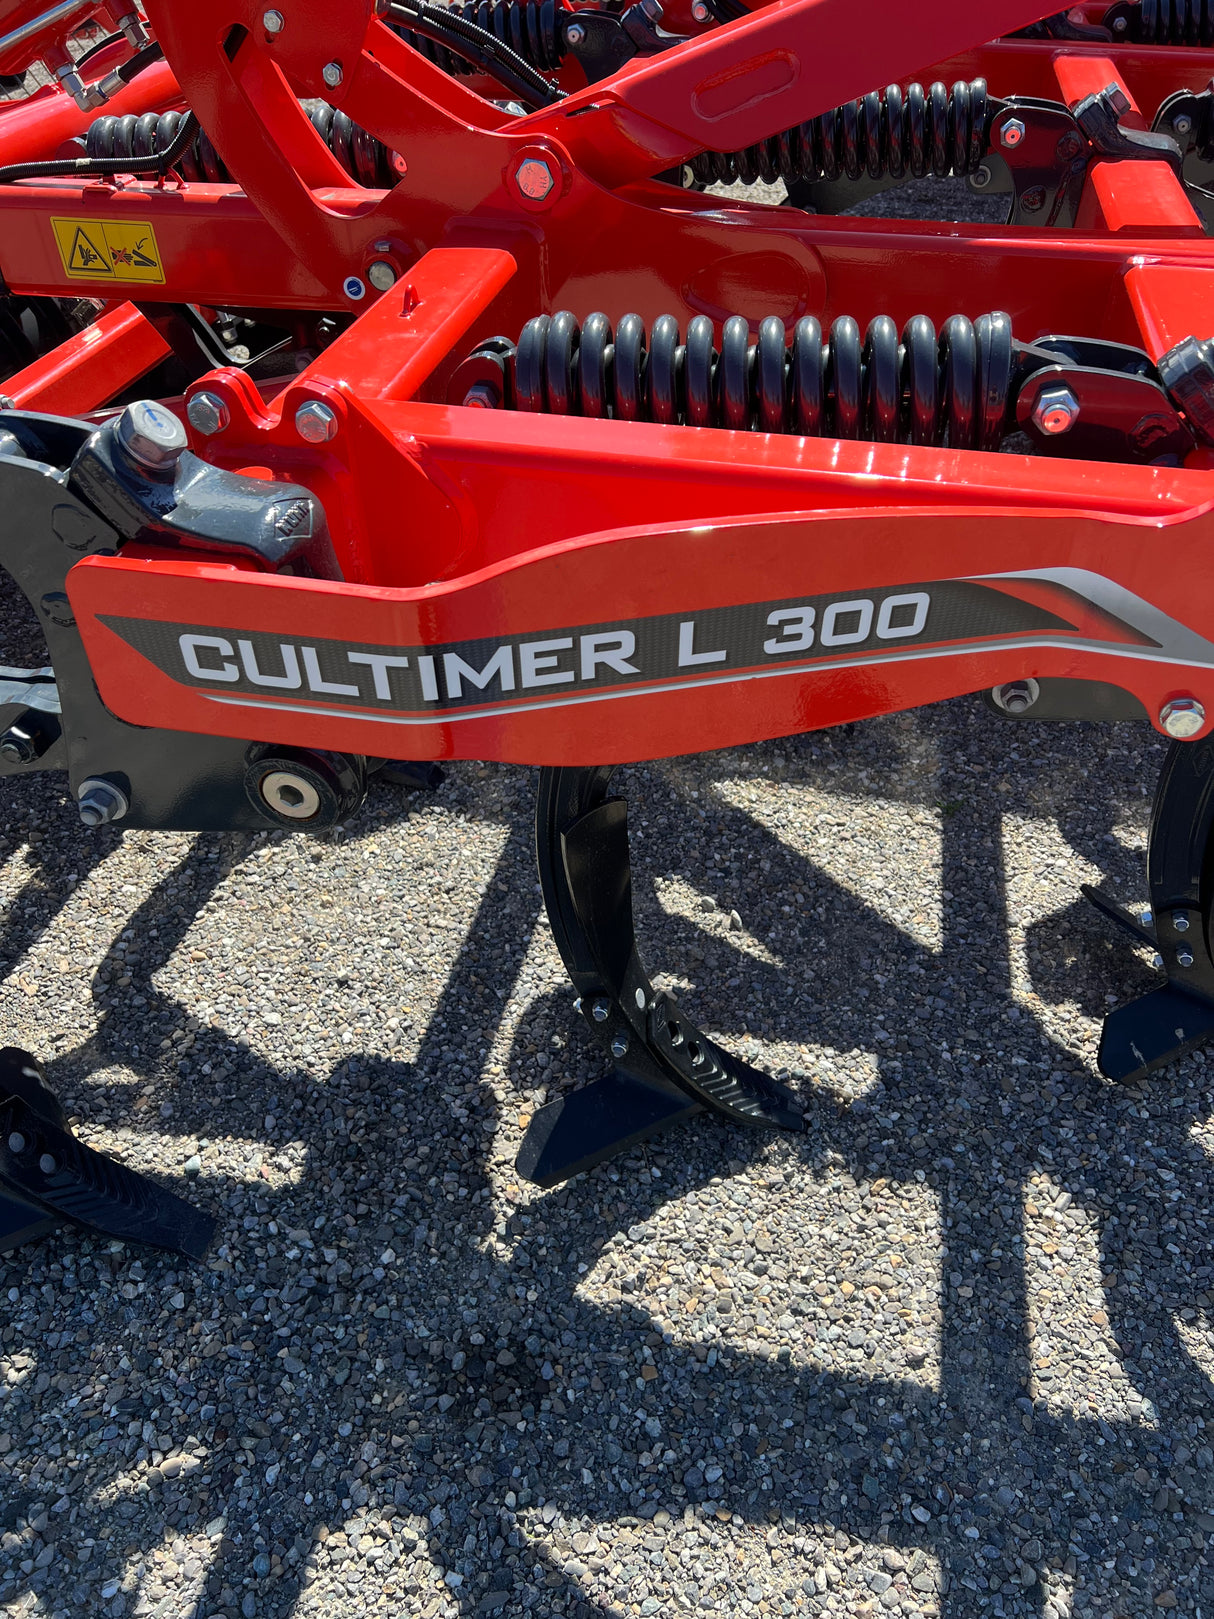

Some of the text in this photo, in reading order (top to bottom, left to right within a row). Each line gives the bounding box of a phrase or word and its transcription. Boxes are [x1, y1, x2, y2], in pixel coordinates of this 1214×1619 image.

[179, 592, 930, 701] CULTIMER L 300
